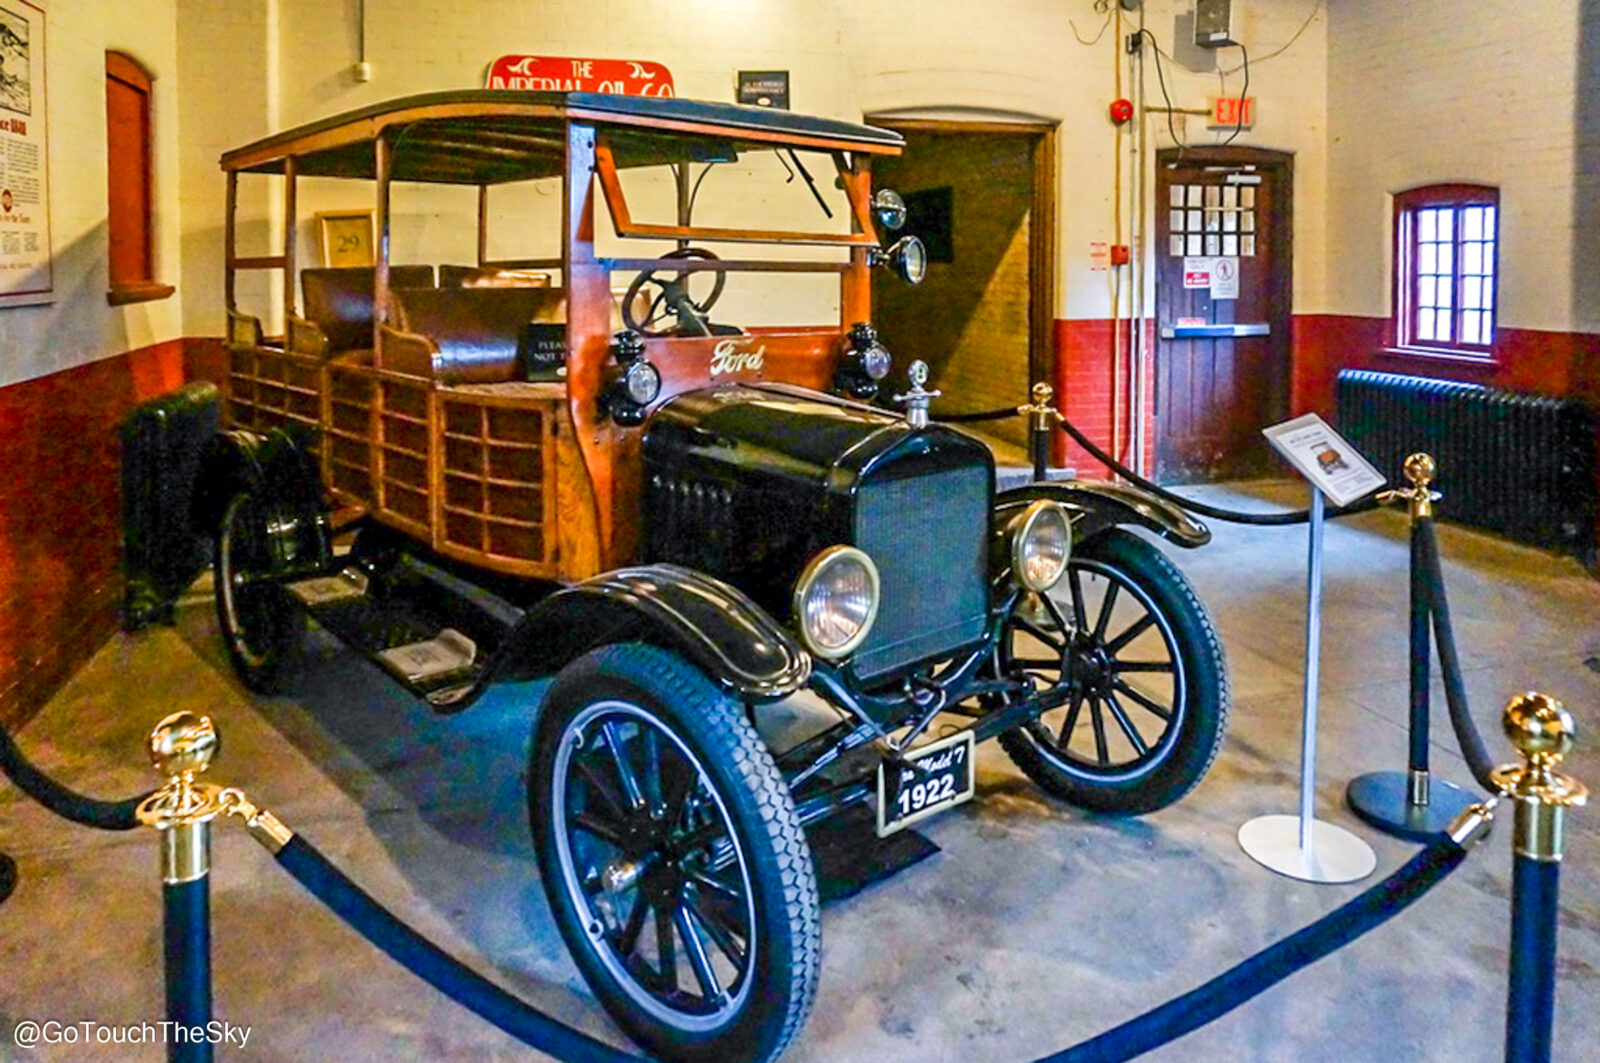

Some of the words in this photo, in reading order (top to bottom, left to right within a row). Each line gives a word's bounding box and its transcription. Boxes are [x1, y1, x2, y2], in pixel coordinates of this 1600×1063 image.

[571, 60, 594, 79] THE
[1216, 98, 1252, 124] EXIT
[710, 339, 766, 376] Ford
[898, 773, 956, 814] 1922
